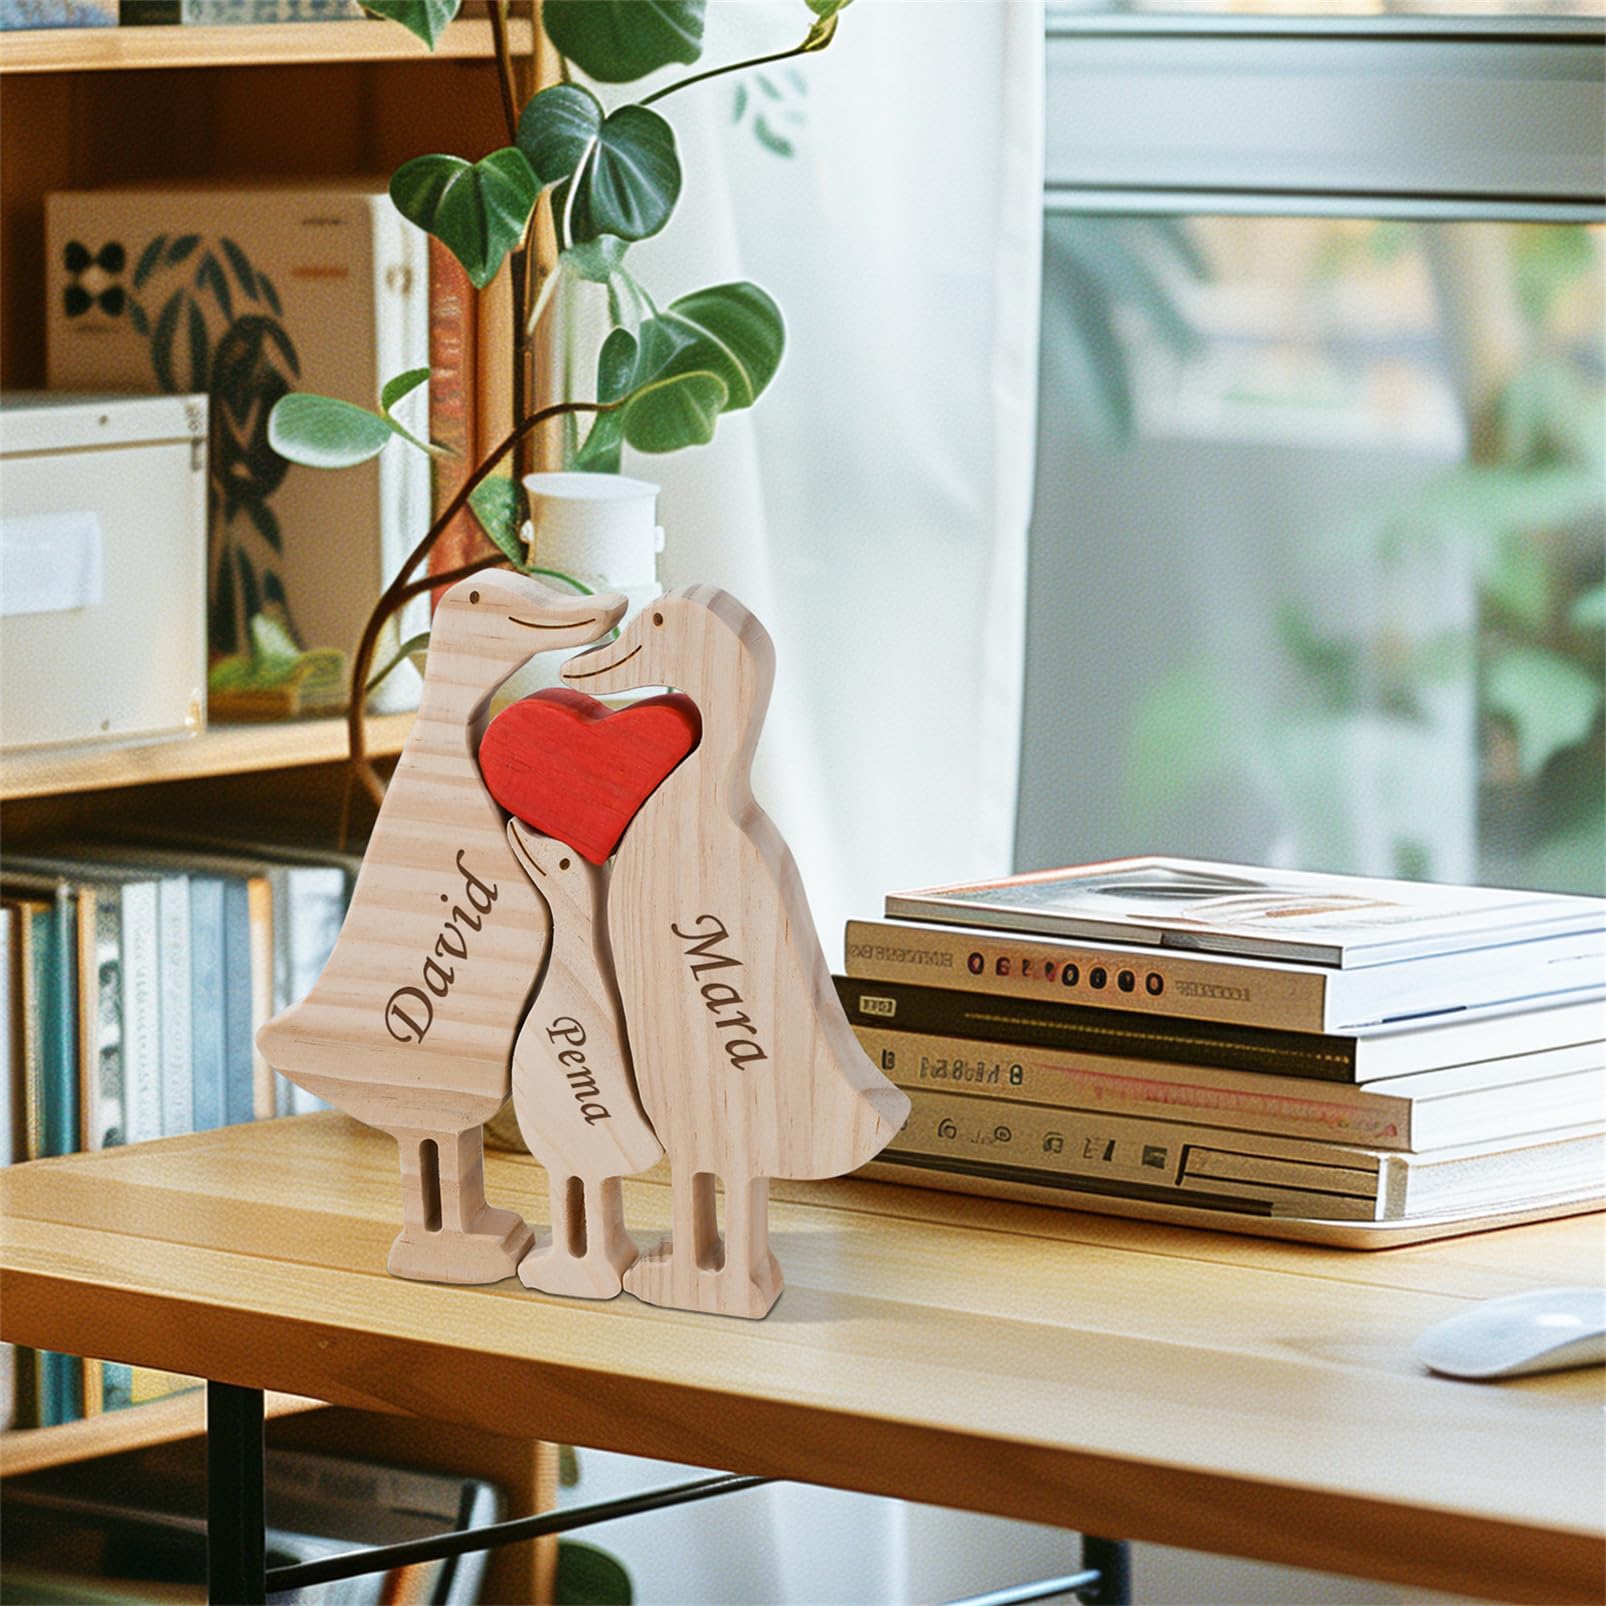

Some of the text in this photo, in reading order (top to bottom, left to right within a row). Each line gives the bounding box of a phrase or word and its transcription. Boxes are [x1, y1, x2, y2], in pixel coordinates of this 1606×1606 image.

[384, 848, 498, 1045] David
[670, 913, 768, 1071] Mara
[545, 1016, 612, 1127] Pema
